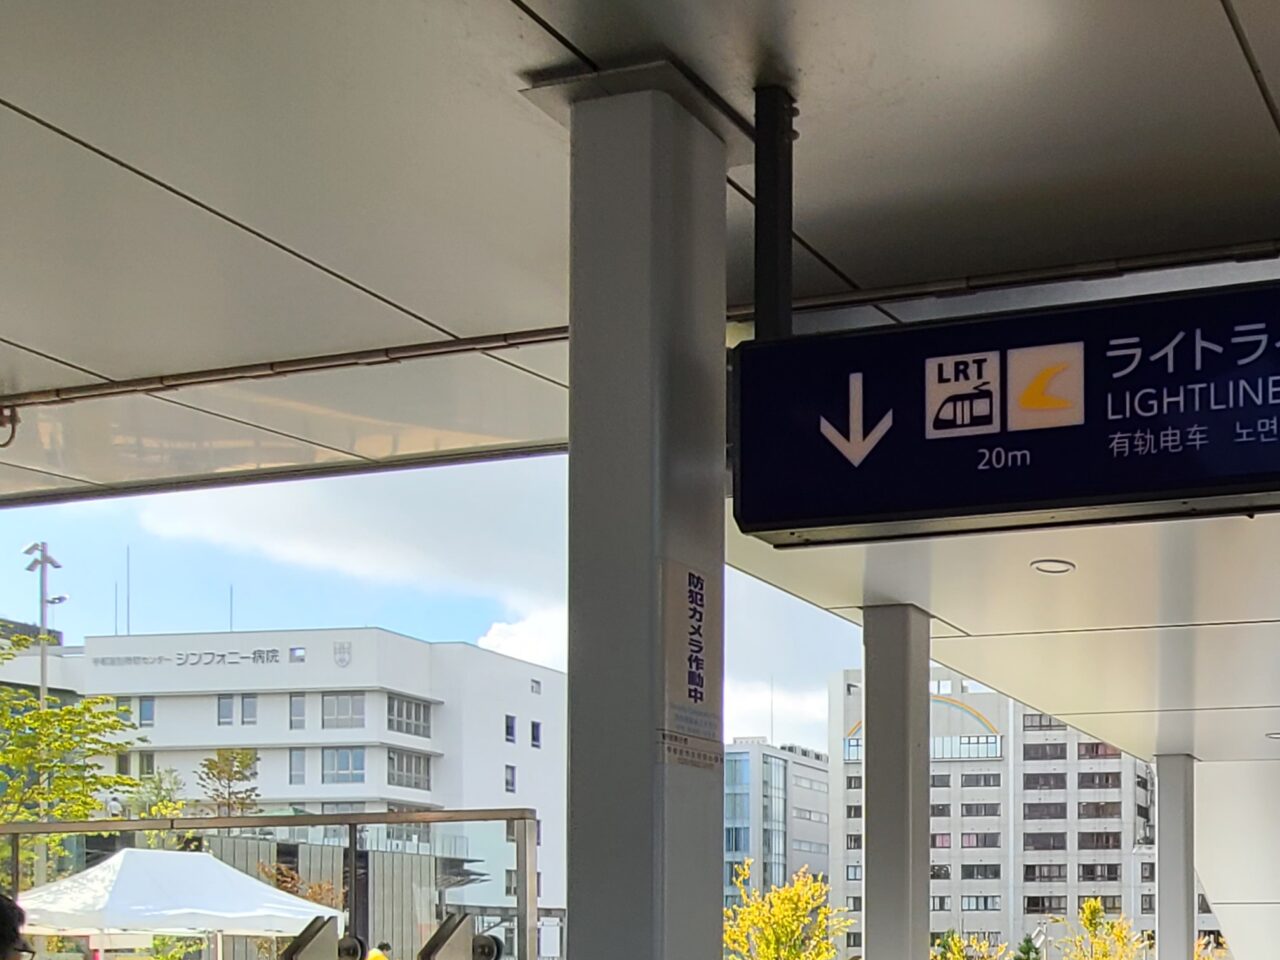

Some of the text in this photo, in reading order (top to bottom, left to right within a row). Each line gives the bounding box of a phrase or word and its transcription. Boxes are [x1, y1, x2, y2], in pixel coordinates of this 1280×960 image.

[937, 358, 988, 384] LRT
[1108, 424, 1210, 457] 有轨电车
[976, 447, 1031, 470] 20m
[687, 571, 705, 704] 防犯カメラ作動中
[176, 649, 280, 666] シンフォニー病院
